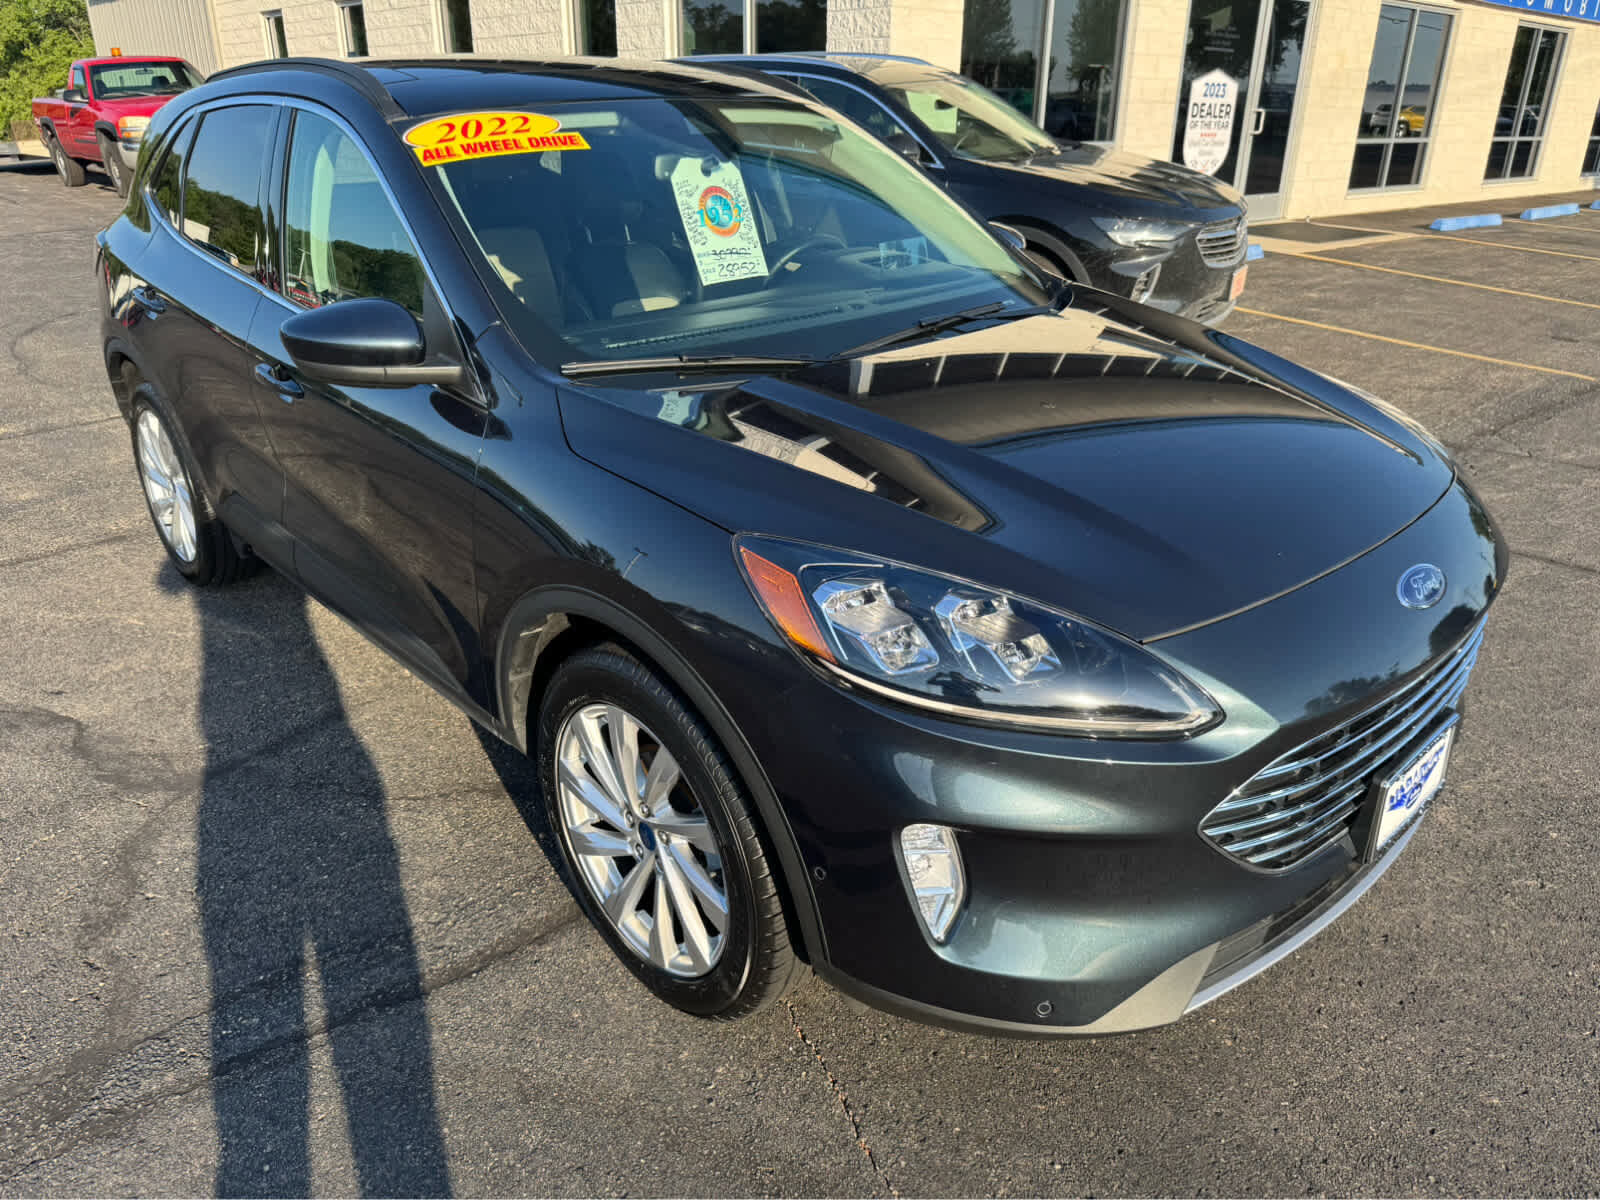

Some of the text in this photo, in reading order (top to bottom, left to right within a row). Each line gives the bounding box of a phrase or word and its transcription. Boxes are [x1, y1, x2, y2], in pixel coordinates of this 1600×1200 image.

[1203, 83, 1227, 98] 2023
[1191, 102, 1232, 119] DEALER
[437, 115, 531, 144] 2022
[1189, 120, 1230, 131] OF THE YEAR
[422, 134, 579, 162] ALL WHEEL DRIVE
[697, 203, 744, 228] 1952
